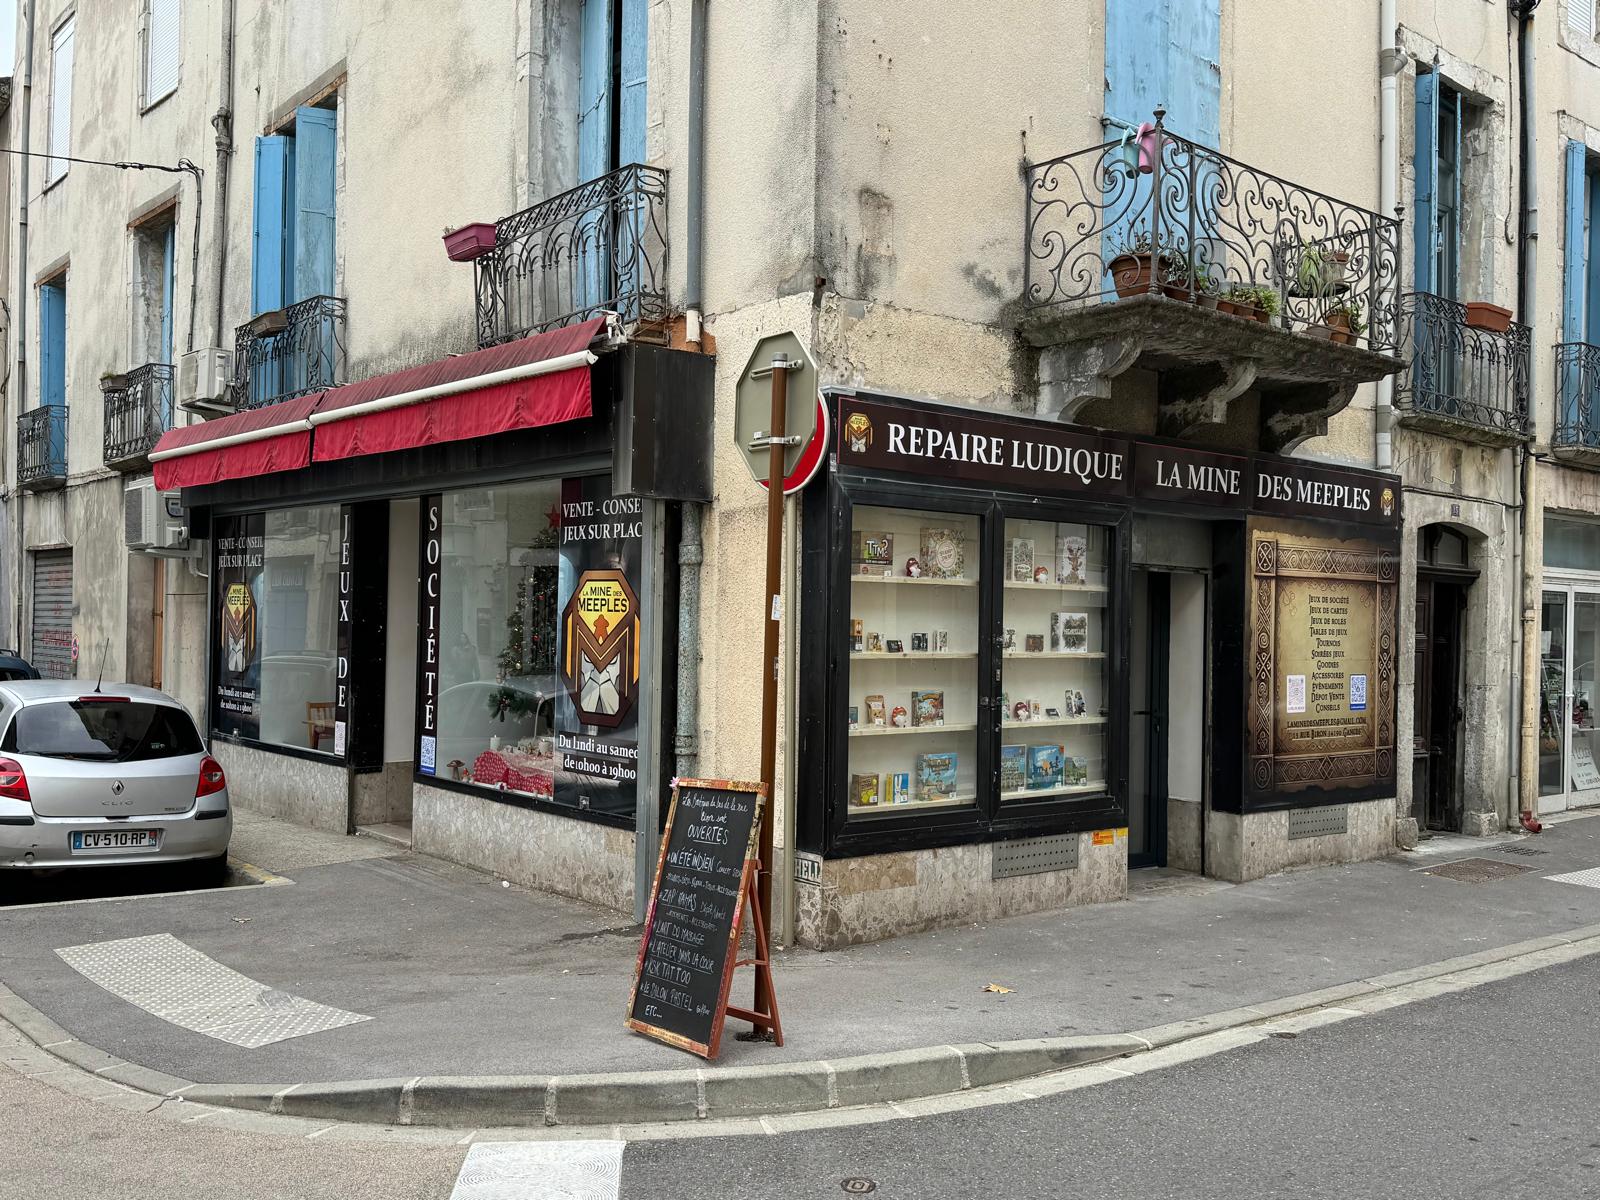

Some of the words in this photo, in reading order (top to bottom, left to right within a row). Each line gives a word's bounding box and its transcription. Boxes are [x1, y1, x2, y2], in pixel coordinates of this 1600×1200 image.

[887, 422, 1004, 466] REPAIRE
[1010, 440, 1123, 485] LUDIQUE
[1156, 459, 1182, 489] LA
[1187, 464, 1240, 495] MINE
[1257, 473, 1292, 501] DES
[1296, 478, 1371, 511] MEEPLES
[562, 501, 594, 518] VENTE
[218, 538, 235, 550] VENTE
[238, 536, 264, 549] CONSEIL
[563, 524, 587, 544] JEUX
[588, 523, 611, 540] SUR
[218, 555, 231, 570] JEUX
[232, 555, 242, 568] SUR
[340, 514, 350, 622] JEUX
[590, 586, 612, 597] MINE
[577, 598, 628, 613] MEEPLES
[424, 506, 440, 730] SOCIÉTÉ
[337, 656, 348, 707] DE
[559, 734, 571, 748] Du
[596, 743, 608, 755] au
[564, 755, 575, 769] de
[602, 761, 607, 775] à
[688, 824, 729, 845] OUVERTES
